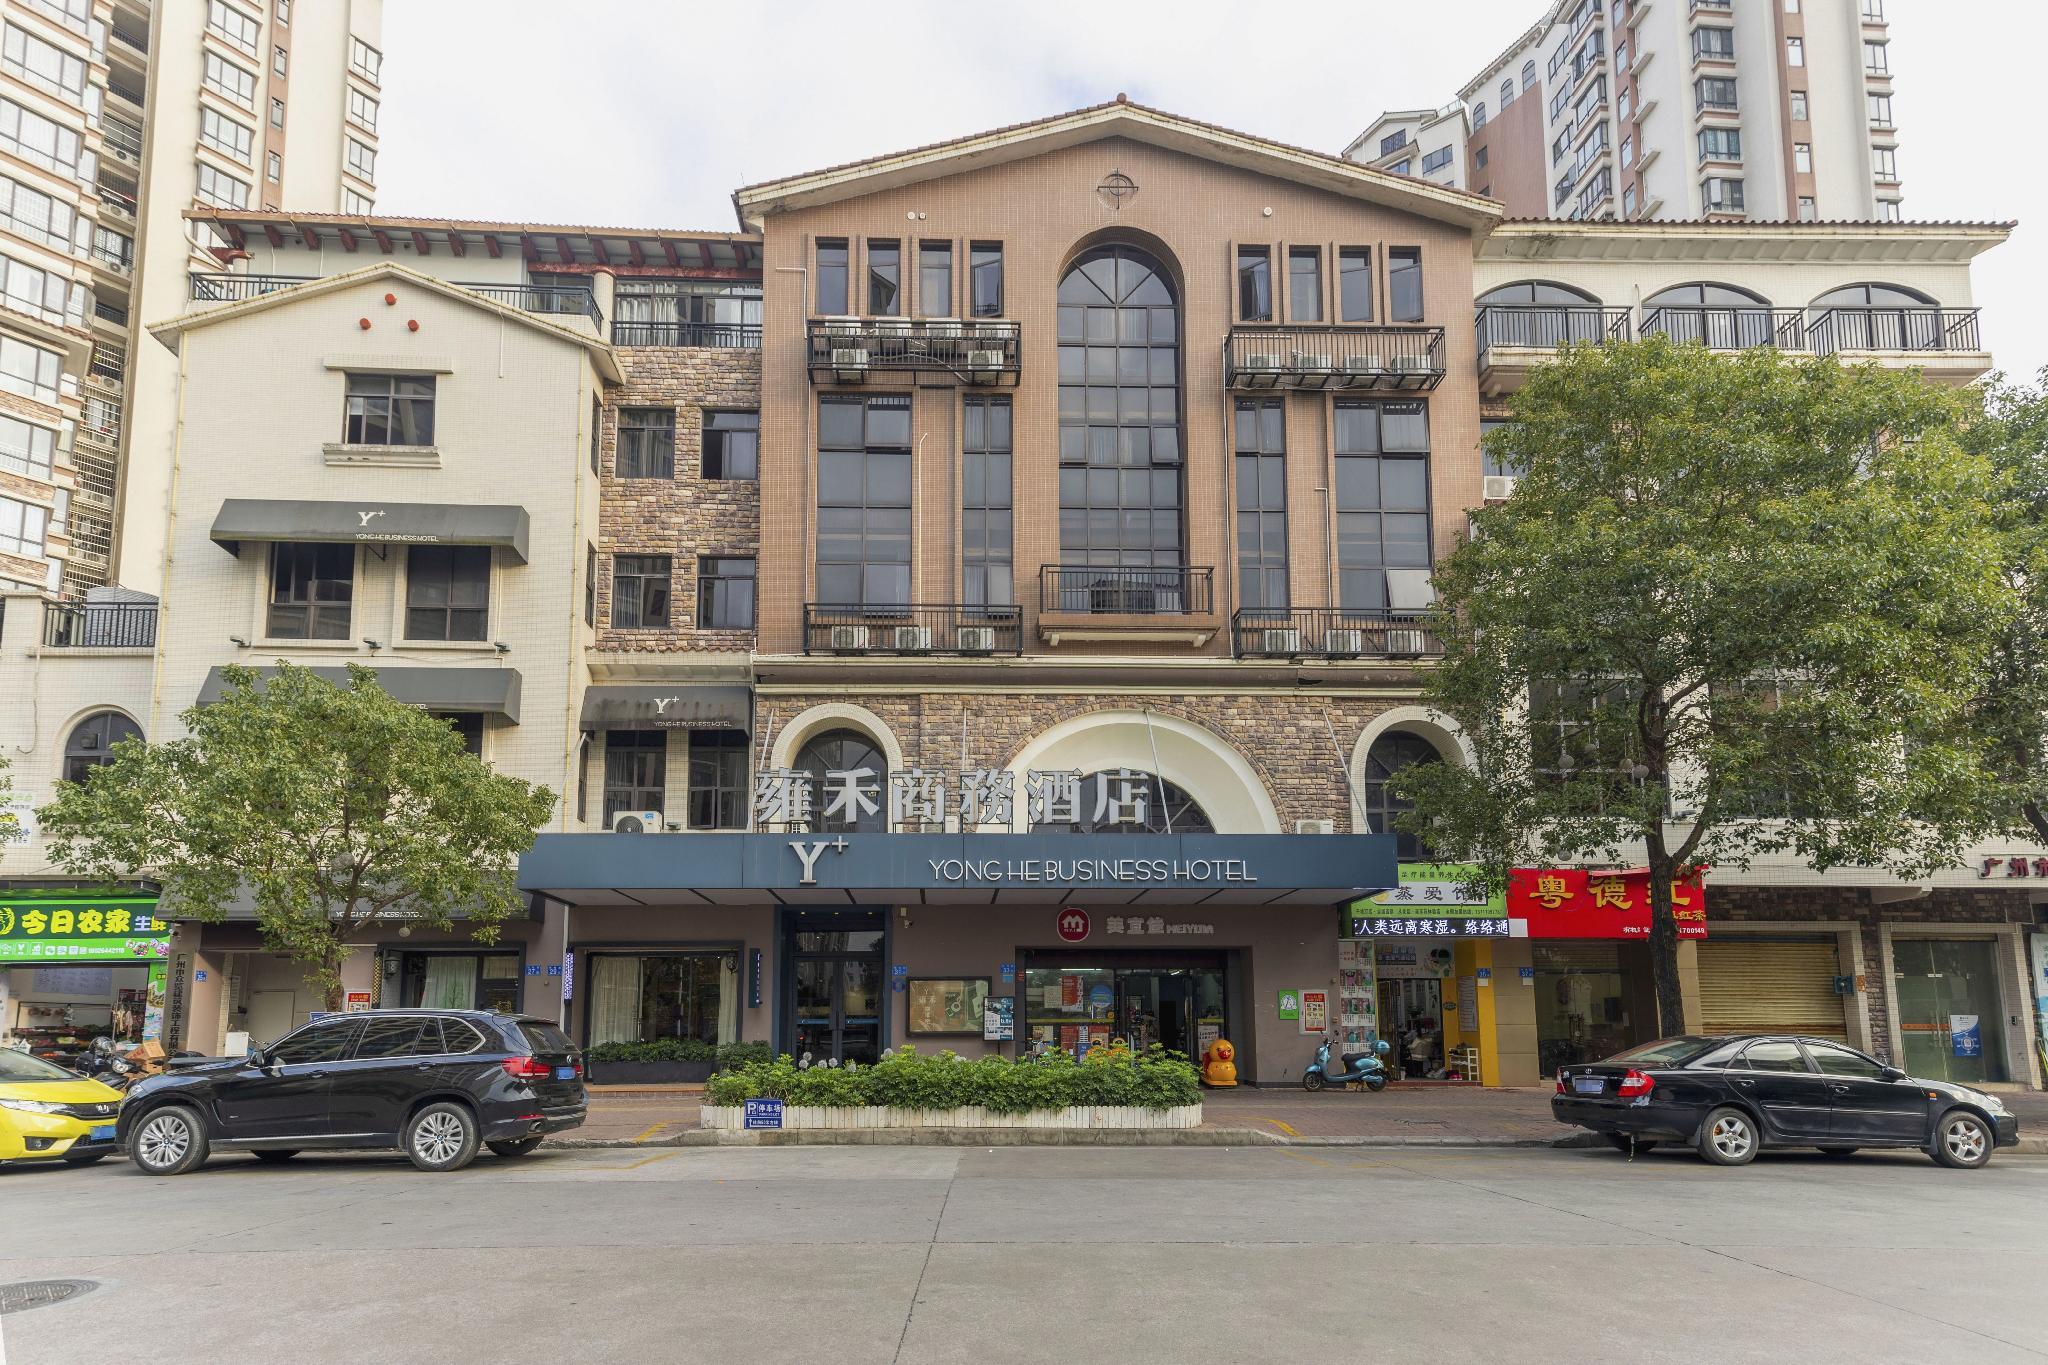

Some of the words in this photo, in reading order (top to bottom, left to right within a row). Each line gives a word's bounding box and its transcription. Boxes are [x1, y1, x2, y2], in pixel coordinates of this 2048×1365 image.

[754, 767, 1148, 825] 雍禾商務酒店
[928, 859, 1003, 881] YONG
[1007, 860, 1041, 881] HE
[1044, 859, 1168, 881] BUSINESS
[1173, 860, 1258, 881] HOTEL
[1355, 919, 1509, 935] 人类远离寒湿。络络通
